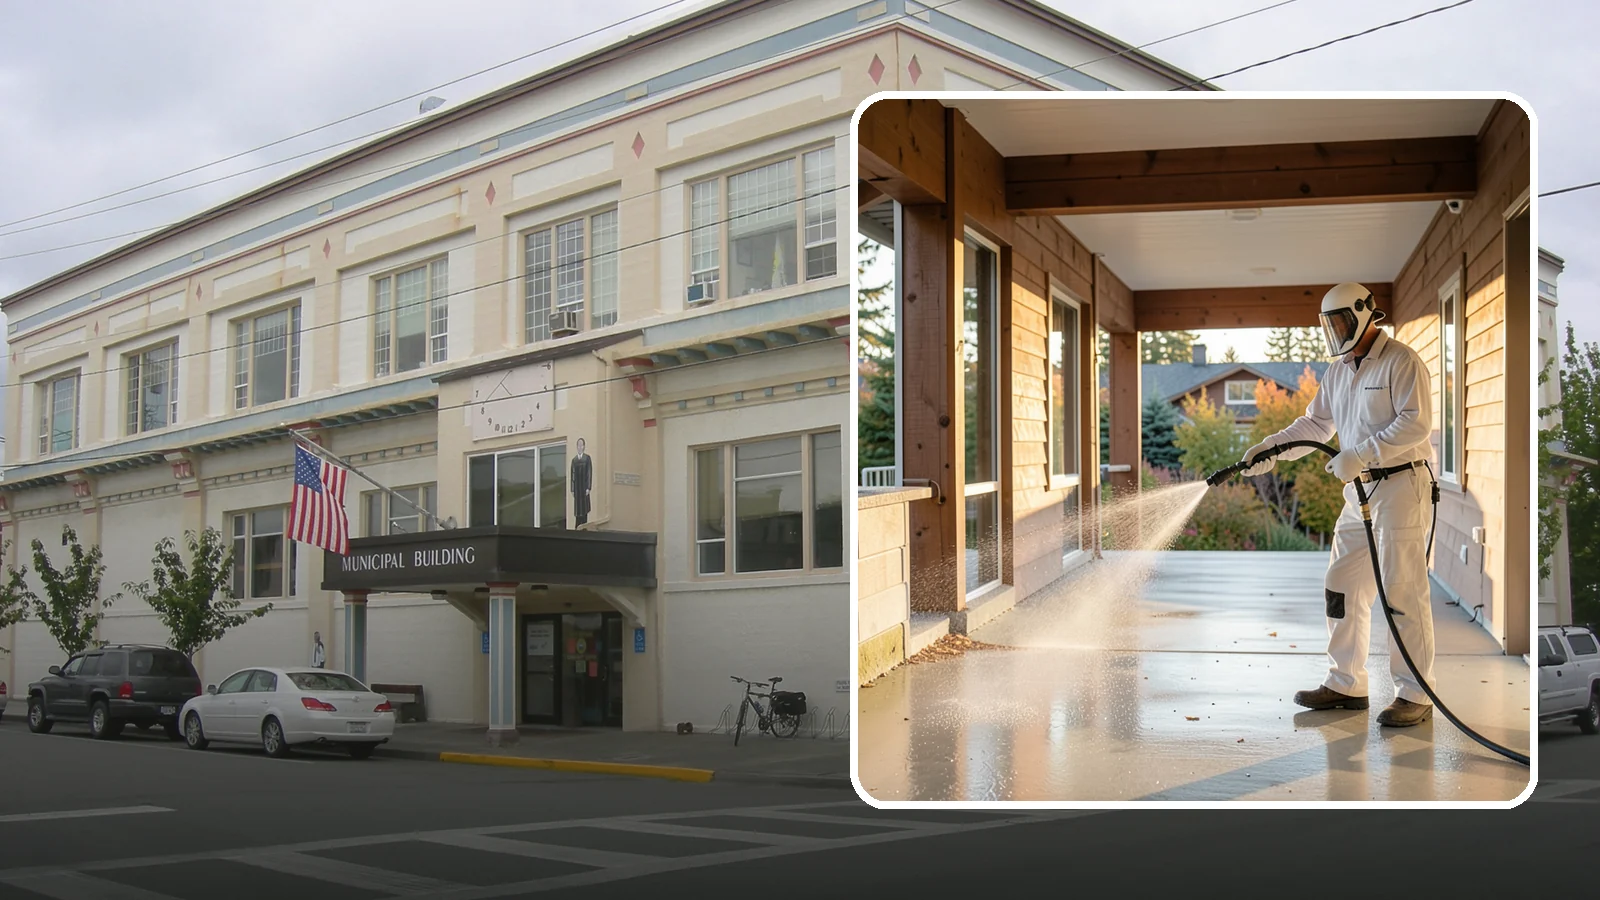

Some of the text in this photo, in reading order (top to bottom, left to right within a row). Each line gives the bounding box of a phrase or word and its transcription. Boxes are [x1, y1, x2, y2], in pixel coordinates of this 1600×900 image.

[546, 362, 552, 370] 6
[487, 417, 492, 426] 9
[494, 423, 500, 432] 10
[507, 425, 513, 433] 12
[342, 546, 475, 572] MUNICIPAL BUILDING
